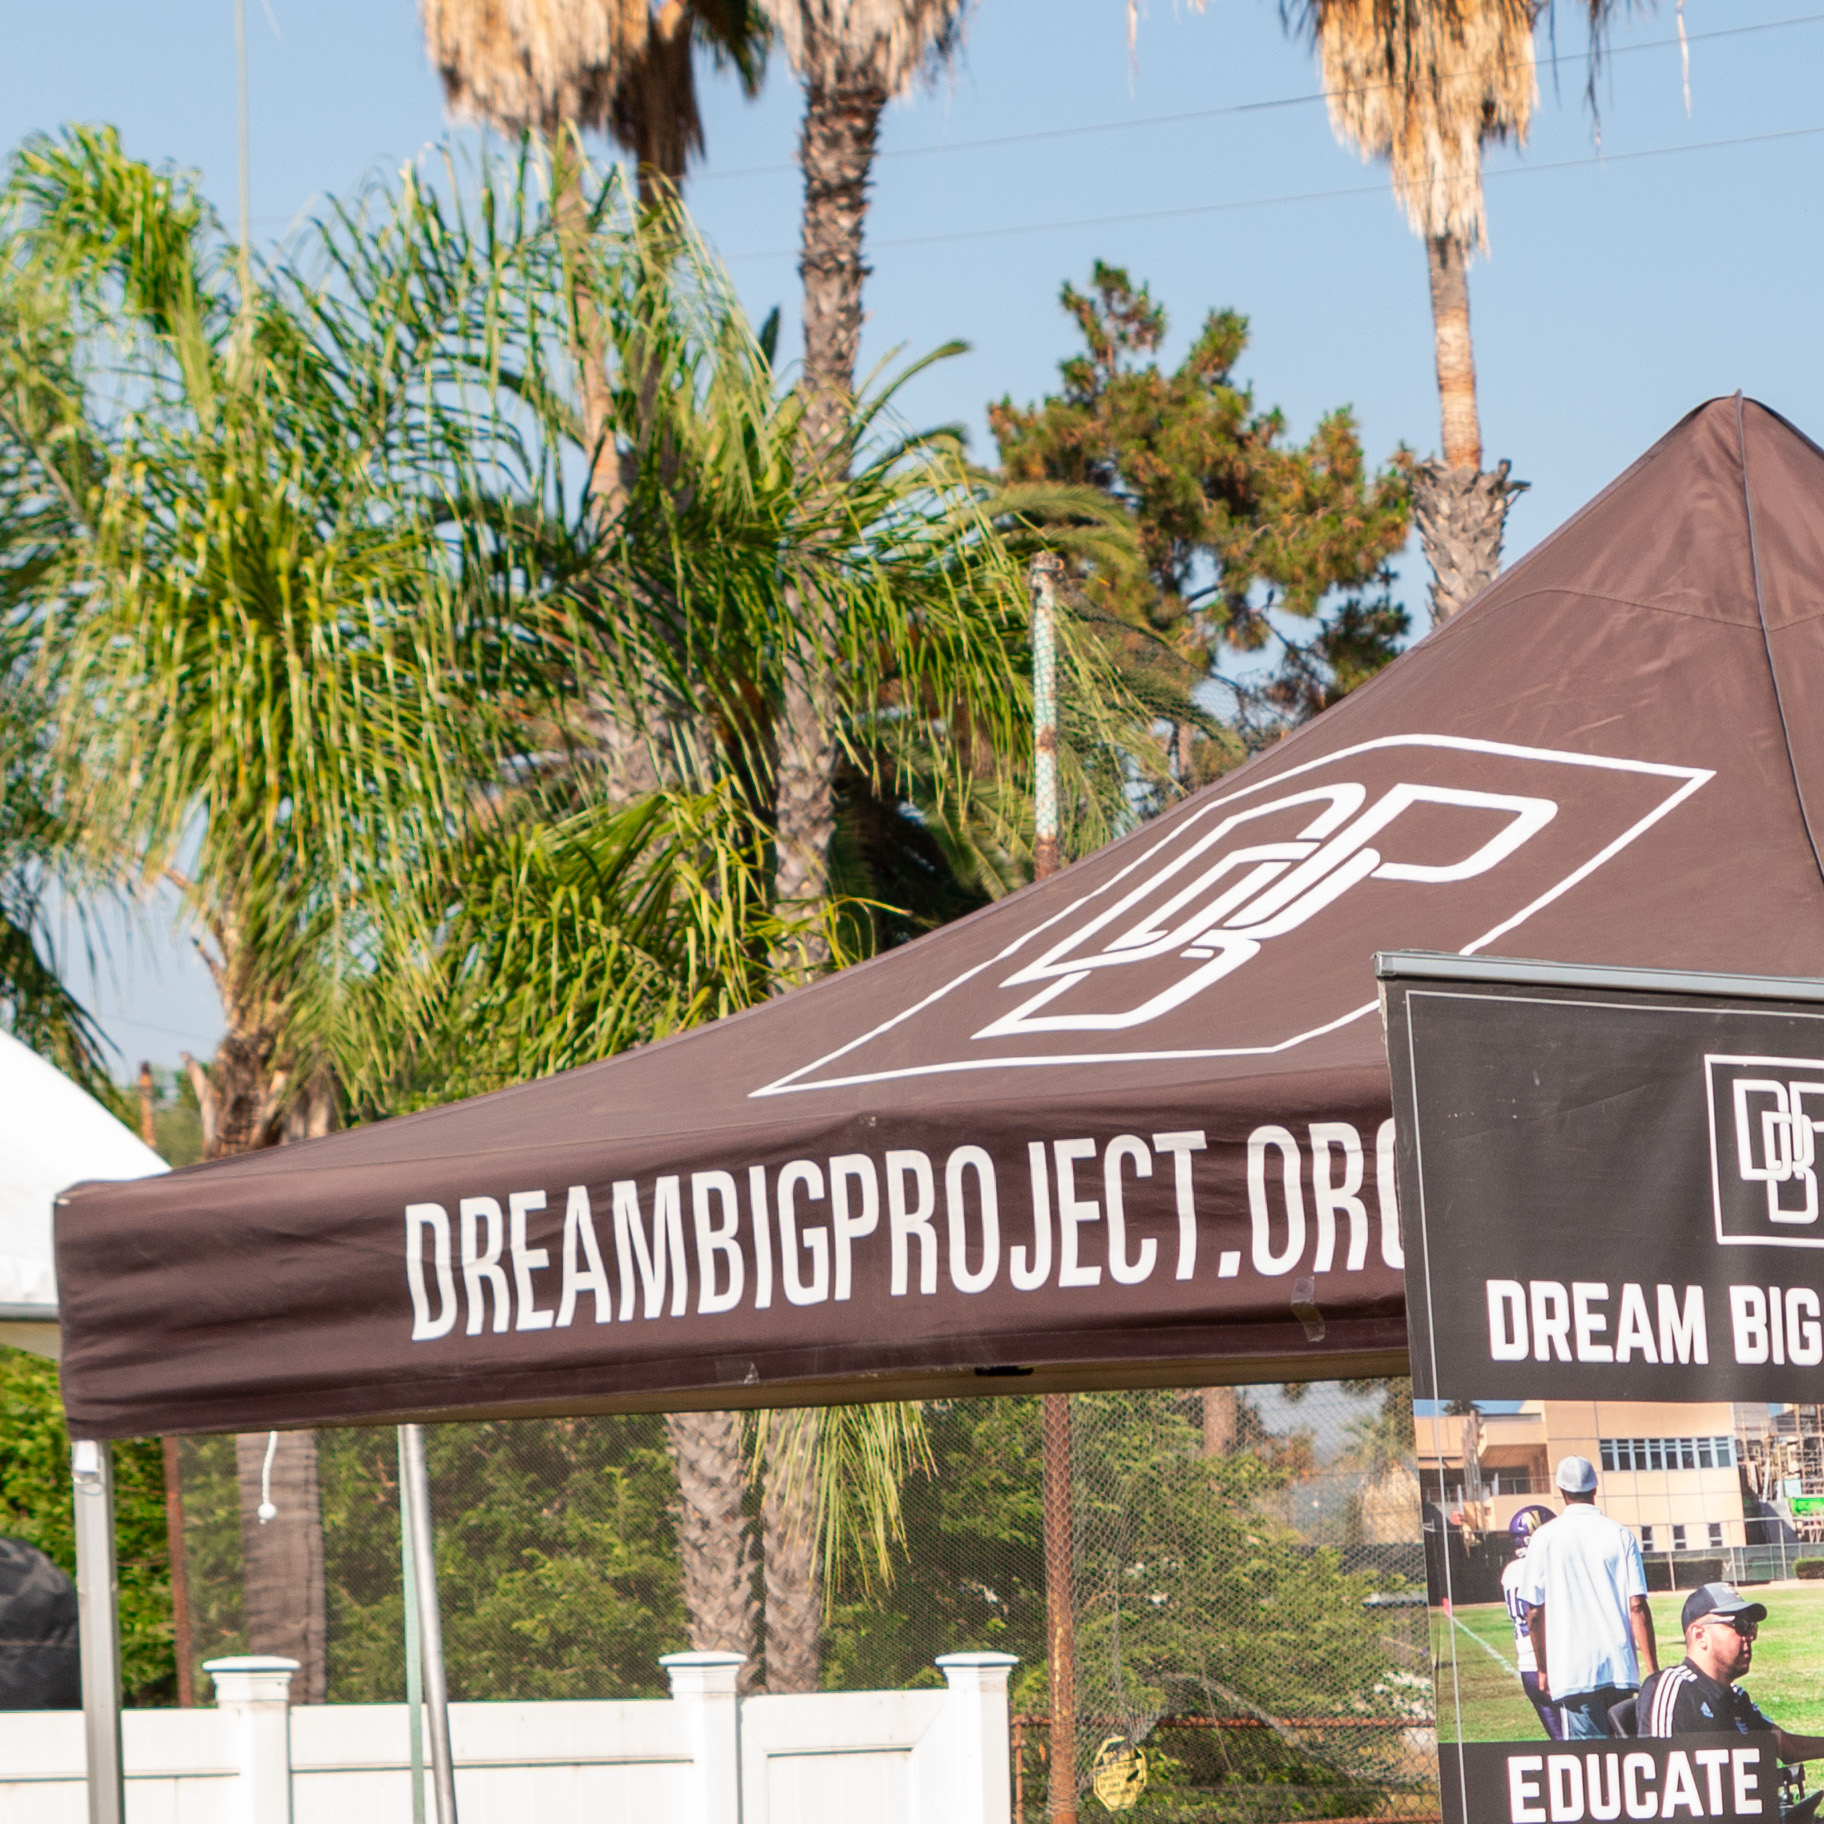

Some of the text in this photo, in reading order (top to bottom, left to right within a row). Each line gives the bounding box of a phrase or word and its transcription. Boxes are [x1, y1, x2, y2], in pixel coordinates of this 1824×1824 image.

[1485, 1279, 1709, 1365] DREAM
[1729, 1284, 1824, 1367] BIG
[1506, 1747, 1764, 1824] EDUCATE
